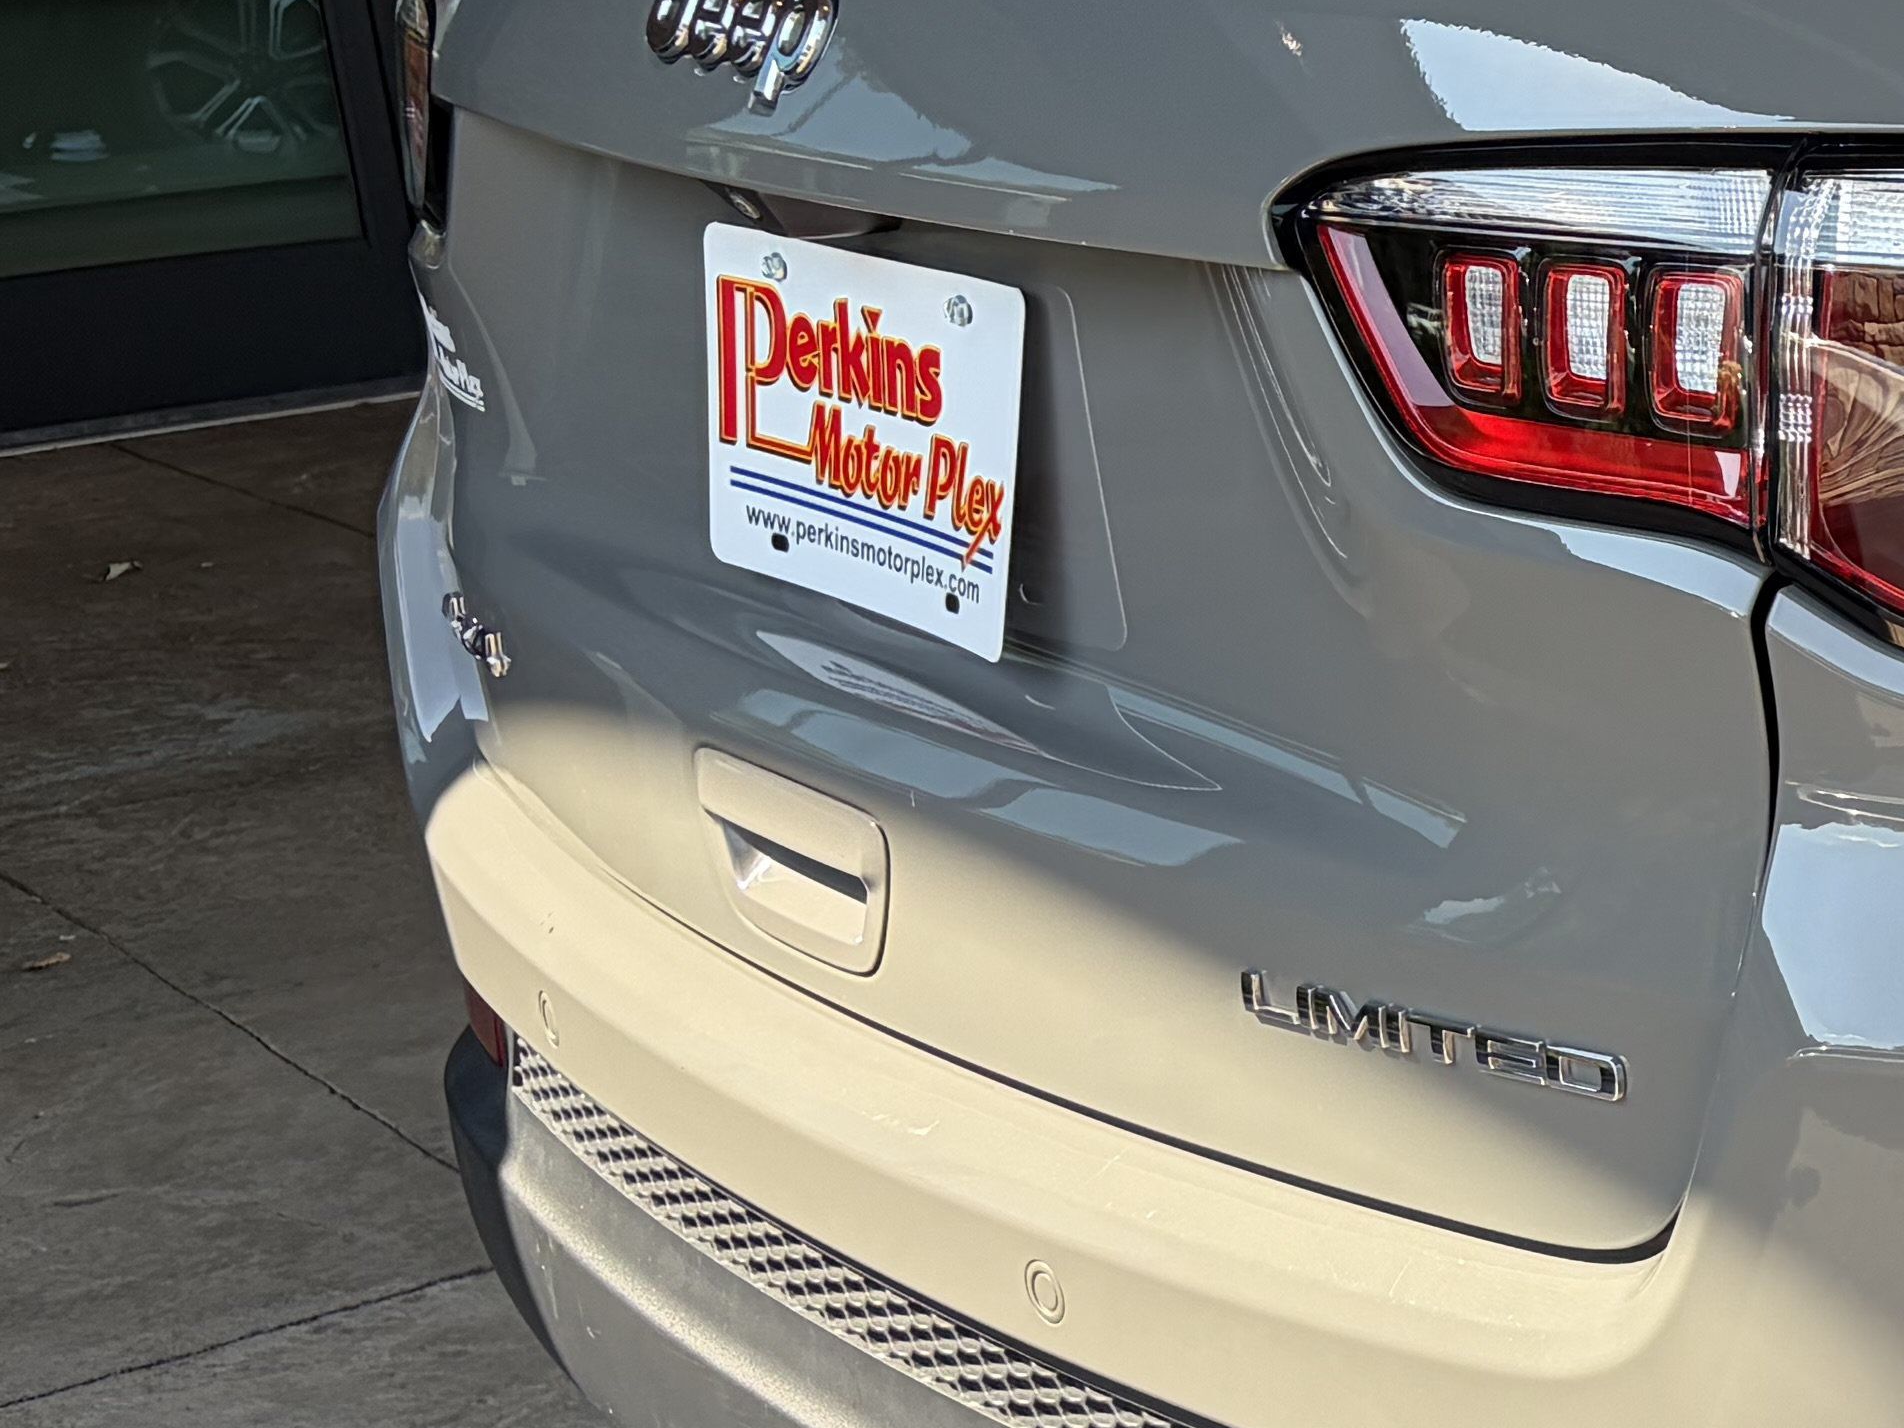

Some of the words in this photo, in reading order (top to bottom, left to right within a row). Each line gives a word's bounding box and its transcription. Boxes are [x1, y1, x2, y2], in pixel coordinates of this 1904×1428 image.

[716, 274, 944, 444] Perkins
[746, 504, 980, 604] www.perkinsmotorplex.com
[808, 400, 924, 510] Motor
[923, 433, 1005, 570] Plex
[1240, 968, 1629, 1104] LIMITED
